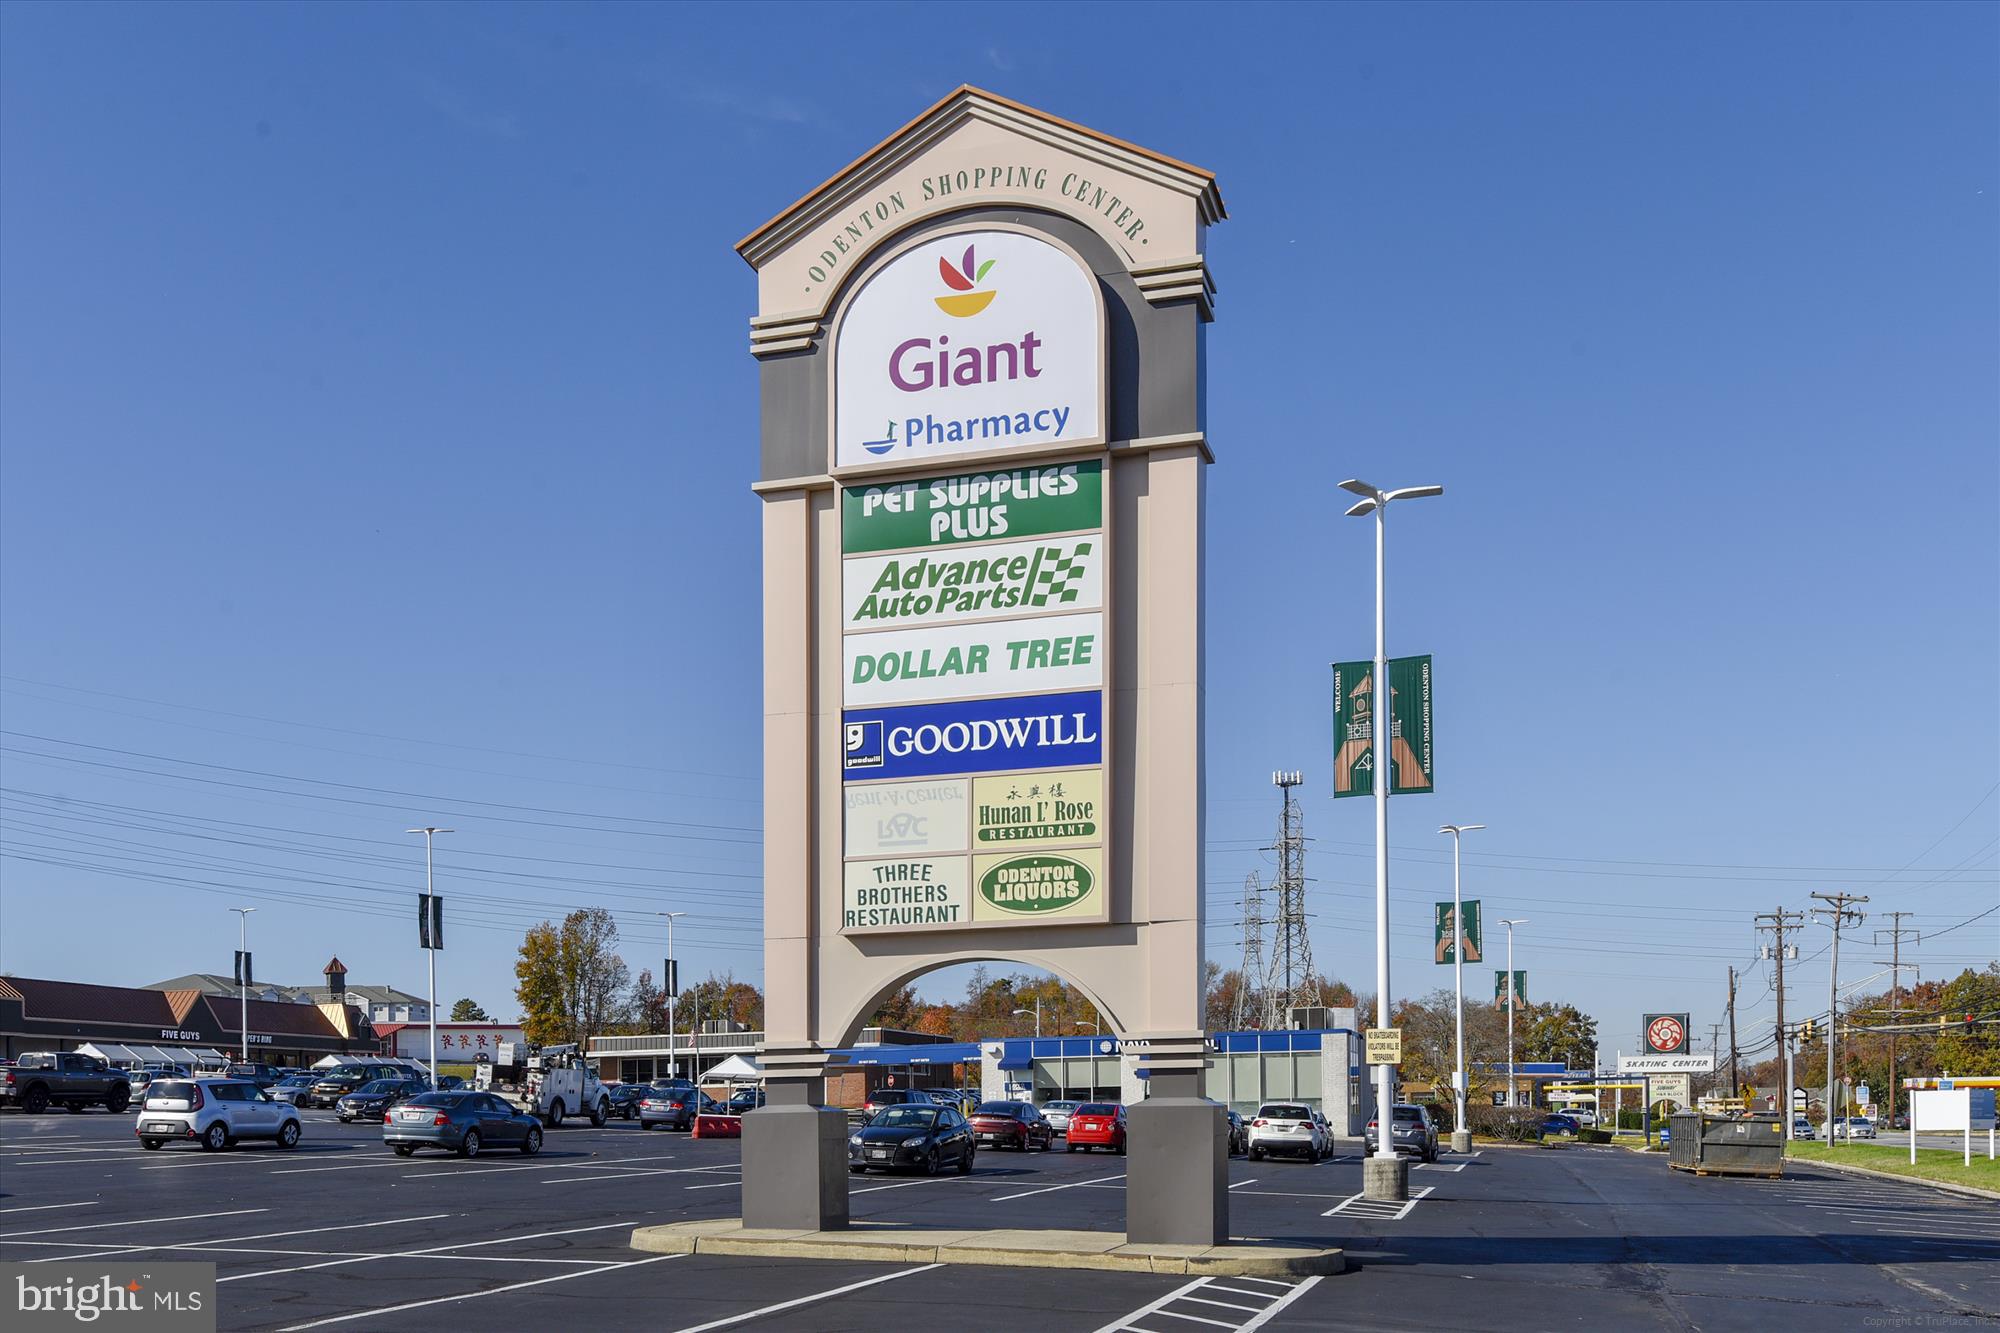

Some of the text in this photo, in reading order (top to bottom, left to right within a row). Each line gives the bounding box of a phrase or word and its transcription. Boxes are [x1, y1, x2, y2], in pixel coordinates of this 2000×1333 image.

[808, 166, 1145, 284] ODENTON SHOPPING CENTER
[889, 331, 1042, 392] Giant
[905, 406, 1070, 447] Pharmacy
[863, 465, 1078, 517] PET SUPPLIES
[930, 505, 1008, 542] PLUS
[870, 556, 1028, 593] Advance
[852, 583, 1021, 621] Auto Parts
[852, 635, 1095, 684] DOLLAR TREE
[888, 712, 1097, 756] GOODWILL
[847, 755, 881, 767] goodwill
[979, 804, 1032, 826] Hunan
[1055, 801, 1093, 820] Rose
[989, 824, 1086, 840] RESTAURANT
[872, 863, 933, 884] THREE
[997, 865, 1075, 883] ODENTON
[857, 884, 948, 906] BROTHERS
[993, 881, 1080, 902] LIQUORS
[846, 904, 960, 927] RESTAURANT
[161, 1029, 200, 1040] FIVE GUYS
[1625, 1060, 1668, 1068] SKATING
